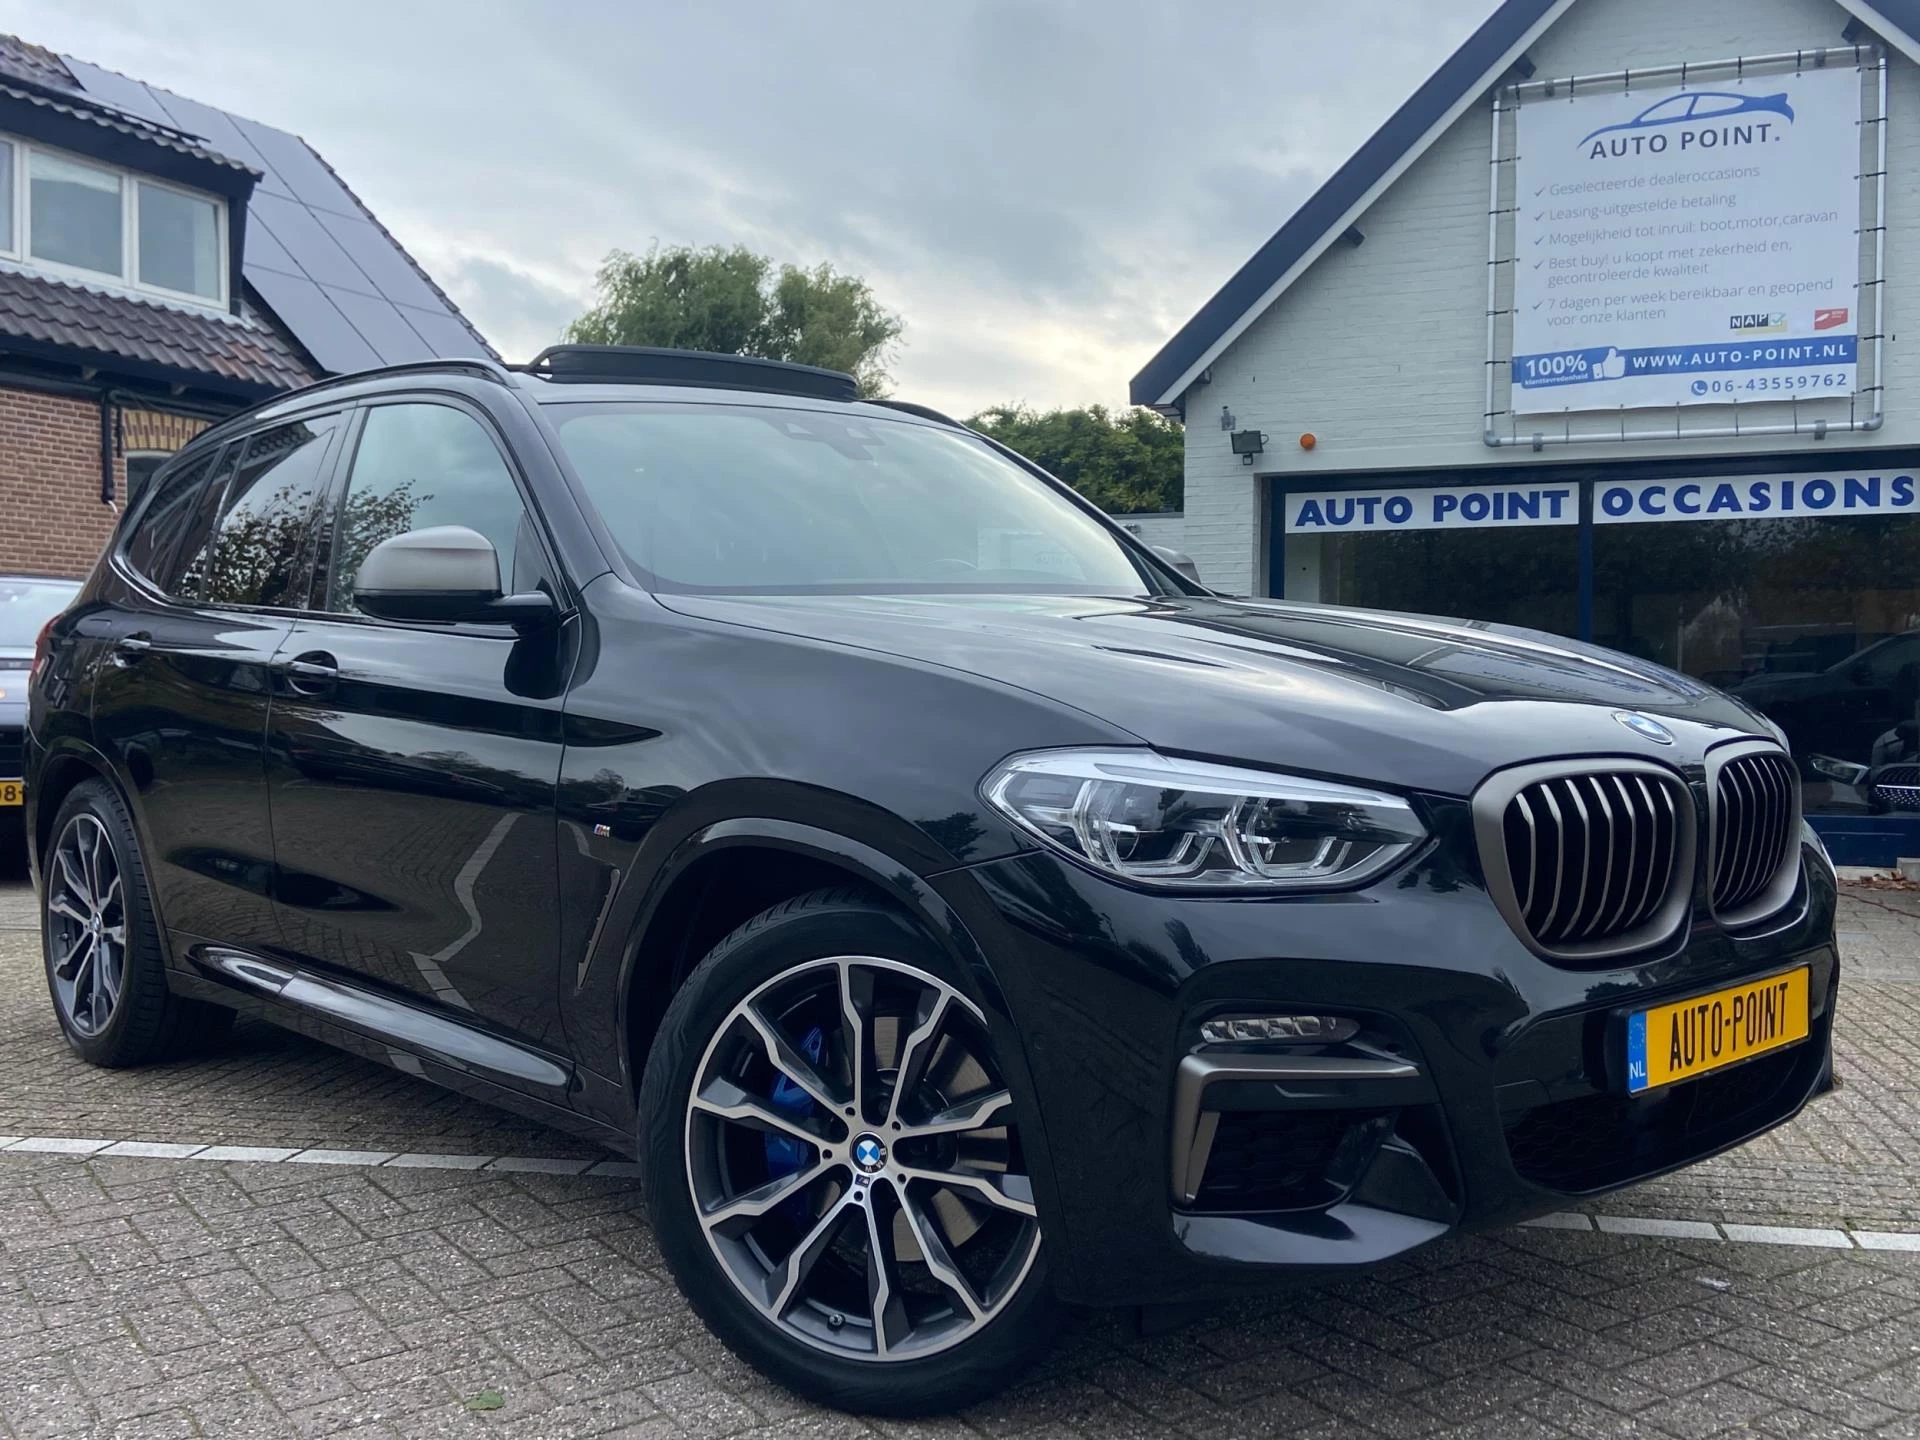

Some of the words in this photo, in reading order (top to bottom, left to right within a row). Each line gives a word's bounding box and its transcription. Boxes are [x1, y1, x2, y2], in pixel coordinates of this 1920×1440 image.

[1590, 134, 1668, 159] AUTO
[1550, 175, 1645, 196] Geselecteerde
[1649, 165, 1760, 186] dealeroccasions
[1549, 198, 1677, 221] Leasing-uitgestelde
[1681, 193, 1737, 209] betaling
[1549, 225, 1632, 246] Mogelijkheid
[1635, 226, 1654, 238] tot
[1548, 256, 1577, 270] Best
[1581, 253, 1609, 270] buy!
[1612, 254, 1621, 264] u
[1625, 249, 1664, 265] koopt
[1667, 247, 1694, 260] met
[1699, 240, 1767, 257] zekerheid
[1771, 240, 1792, 253] en,
[1547, 267, 1650, 289] gecontroleerde
[1653, 262, 1709, 278] kwaliteit
[1548, 298, 1556, 309] 7
[1559, 295, 1600, 312] dagen
[1604, 294, 1626, 309] per
[1630, 290, 1666, 304] week
[1669, 285, 1743, 302] bereikbaar
[1748, 284, 1766, 296] en
[1769, 278, 1834, 298] geopend
[1547, 314, 1577, 327] voor
[1580, 312, 1613, 325] onze
[1616, 308, 1666, 322] klanten
[1731, 312, 1768, 328] NAP
[1525, 354, 1588, 377] 100%
[1632, 343, 1848, 369] WWW.AUTO-POINT.NL
[1712, 373, 1847, 393] 06-43559762
[1295, 495, 1413, 527] AUTO
[1432, 489, 1570, 523] POINT
[1601, 475, 1915, 517] OCCASIONS
[1669, 982, 1788, 1072] AUTO-POINT
[1629, 1062, 1646, 1080] NL
